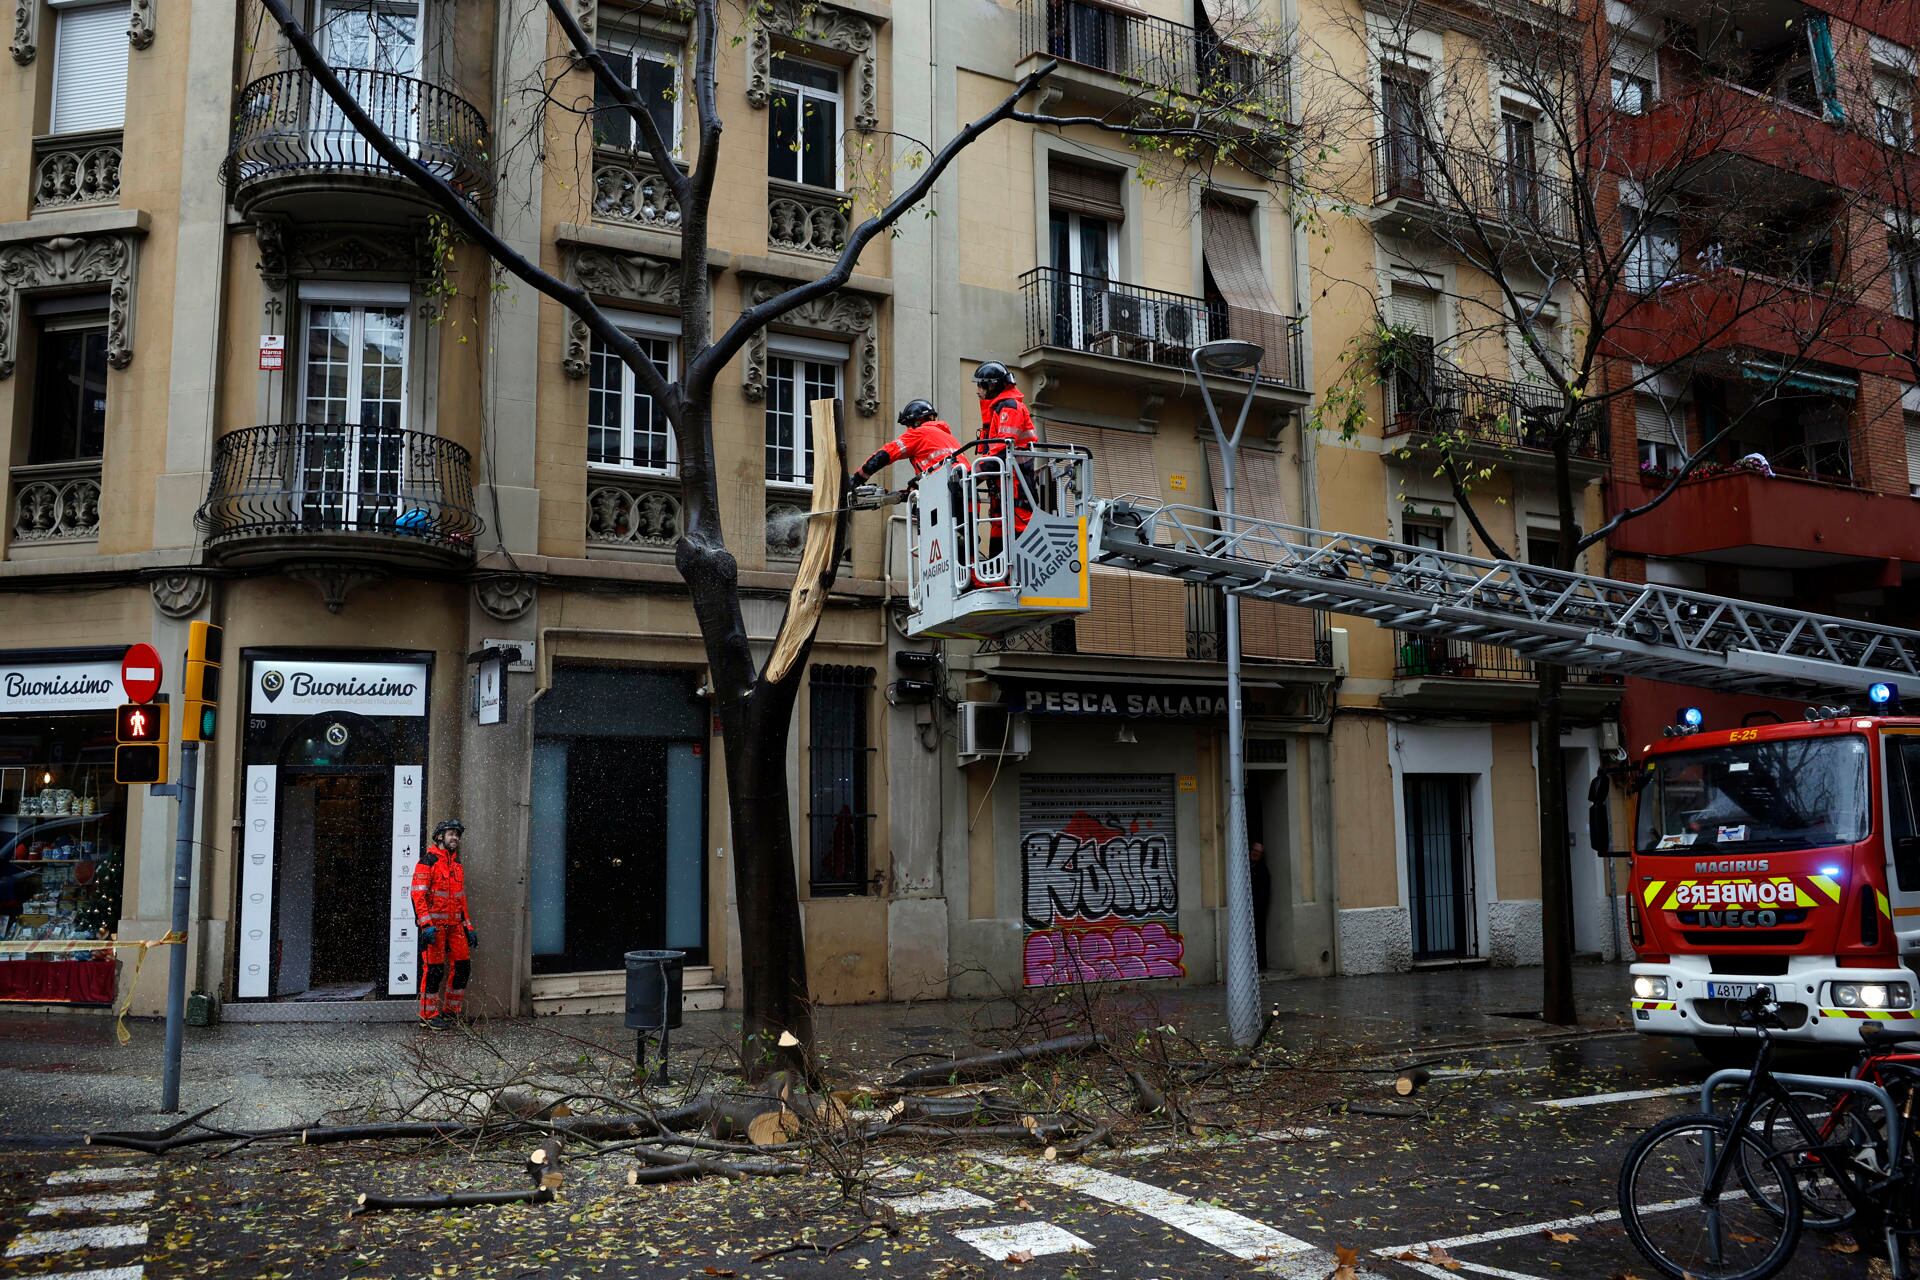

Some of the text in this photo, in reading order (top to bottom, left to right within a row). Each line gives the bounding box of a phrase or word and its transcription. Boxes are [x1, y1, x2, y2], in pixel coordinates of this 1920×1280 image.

[922, 560, 950, 581] MAGIRUS
[1030, 540, 1079, 592] MAGIRUS
[5, 672, 113, 697] Buonissimo
[290, 672, 417, 696] Buonissimo
[1025, 690, 1118, 713] PESCA
[1127, 694, 1229, 715] SALADA
[250, 719, 266, 728] 570
[1729, 729, 1758, 741] E-25
[1695, 860, 1769, 873] MAGIRUS
[1699, 910, 1777, 928] IVECO
[1717, 985, 1743, 998] 4817
